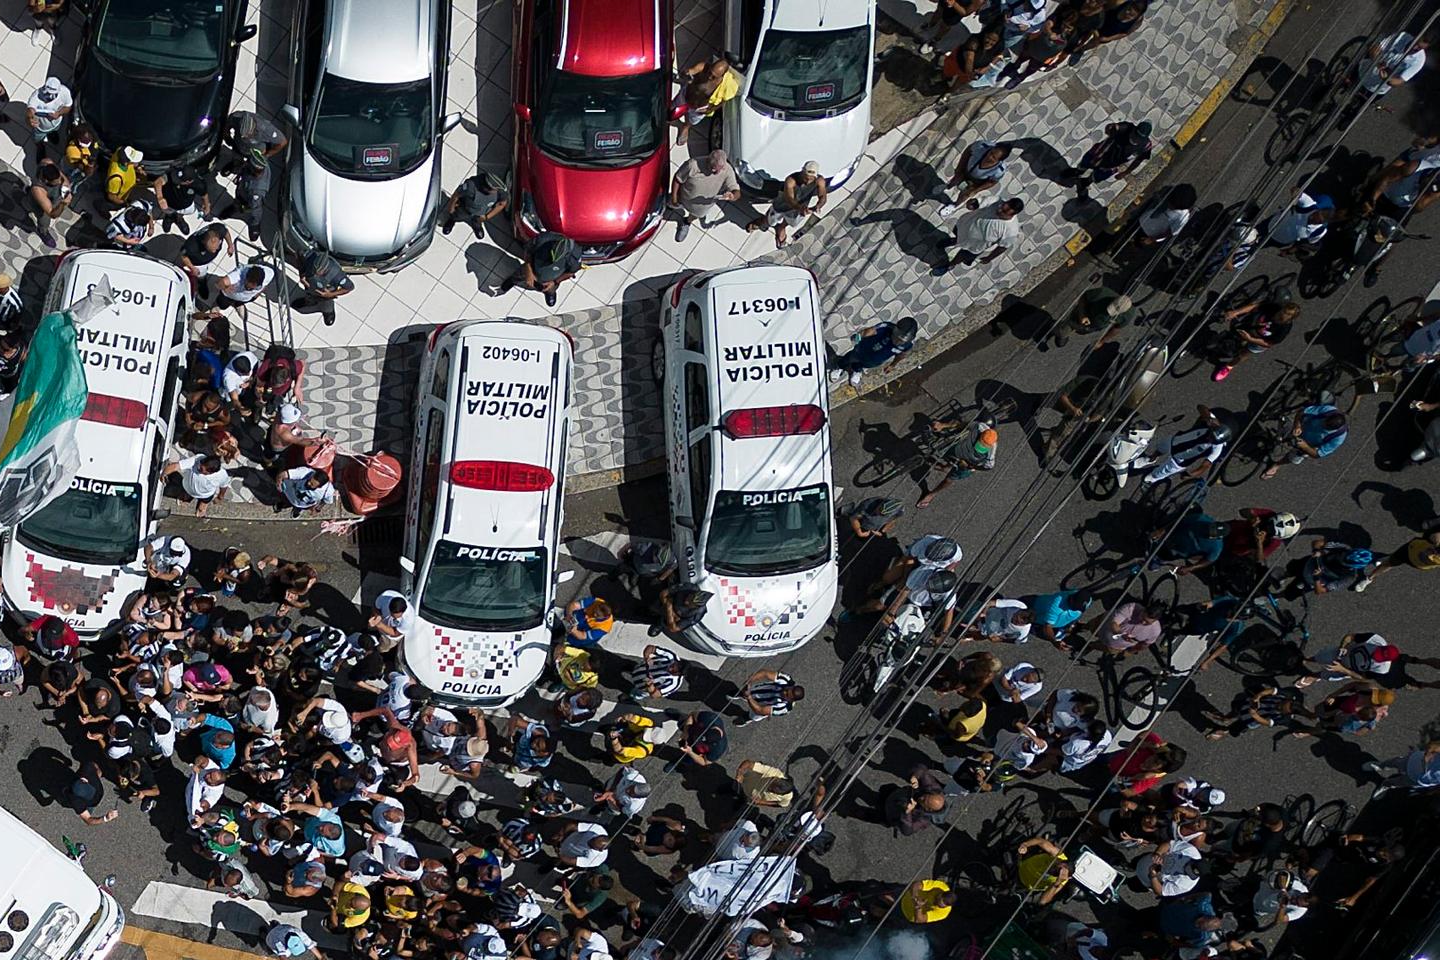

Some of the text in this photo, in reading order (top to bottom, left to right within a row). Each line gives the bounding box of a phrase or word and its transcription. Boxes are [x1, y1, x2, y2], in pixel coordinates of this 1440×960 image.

[728, 296, 801, 316] I-06317
[80, 347, 152, 377] POLÍCI
[482, 345, 541, 363] I-06402
[724, 341, 812, 362] MILITAR
[725, 362, 813, 384] POLÍCIA
[464, 380, 550, 401] MILITAR
[467, 399, 547, 420] POLÍCIA
[71, 477, 117, 496] OLÍCIA
[456, 546, 526, 562] POLÍCIA
